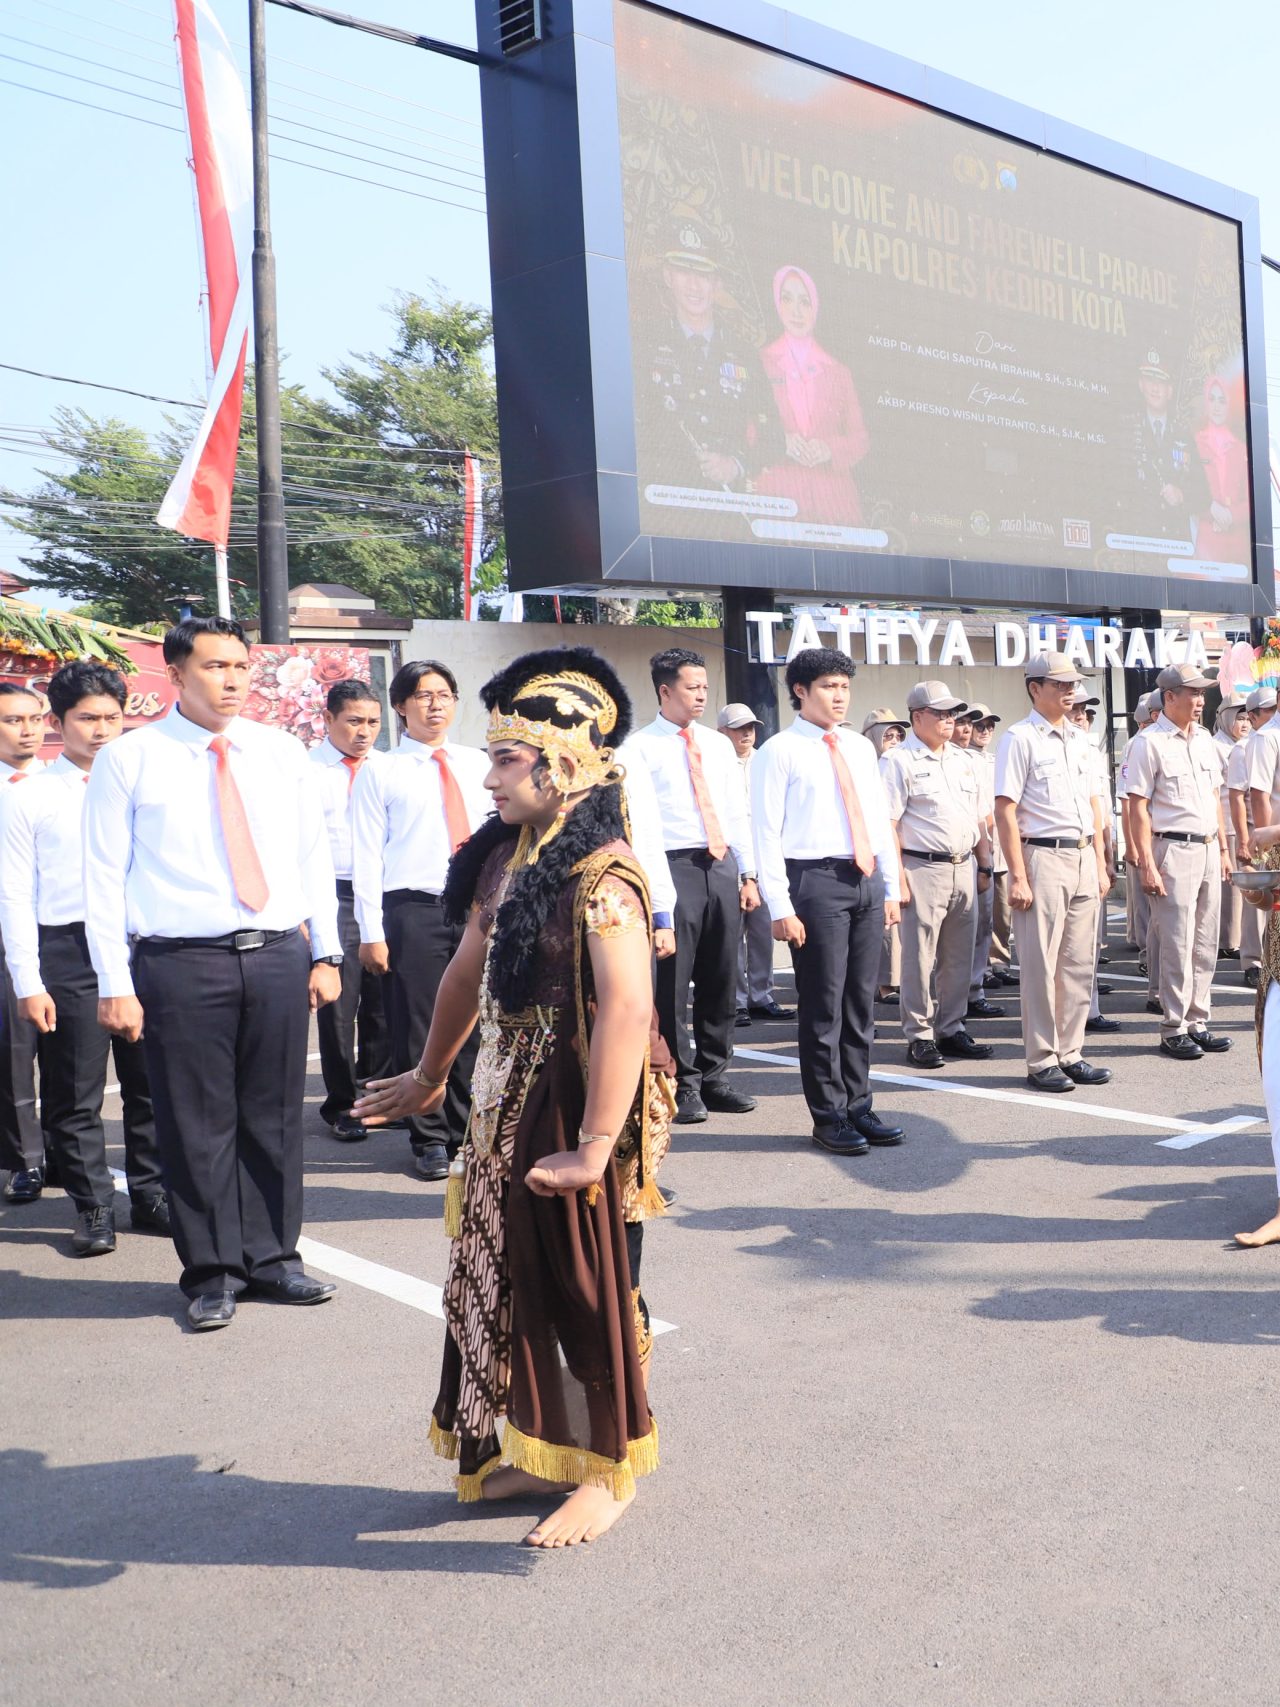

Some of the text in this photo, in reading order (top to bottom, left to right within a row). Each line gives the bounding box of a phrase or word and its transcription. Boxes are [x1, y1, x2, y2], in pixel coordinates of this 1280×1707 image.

[740, 142, 1179, 310] WELCOME AND FAREWELL PARADE
[831, 220, 1127, 337] KAPOLRES KEDIRI KOTA
[867, 335, 897, 349] AKBP
[900, 341, 915, 353] Dr.
[917, 345, 950, 361] ANGGI
[952, 353, 998, 371] SAPUTRA
[1000, 363, 1043, 381] IBRAHIM,
[975, 331, 1016, 354] Dari
[877, 395, 906, 408] AKBP
[908, 401, 950, 417] KRESNO
[952, 409, 985, 423] WISNU
[987, 415, 1039, 433] PUTRANTO,
[967, 382, 1029, 407] Kepada
[1067, 527, 1088, 541] 110
[745, 611, 1208, 668] TATHYA DHARAKA
